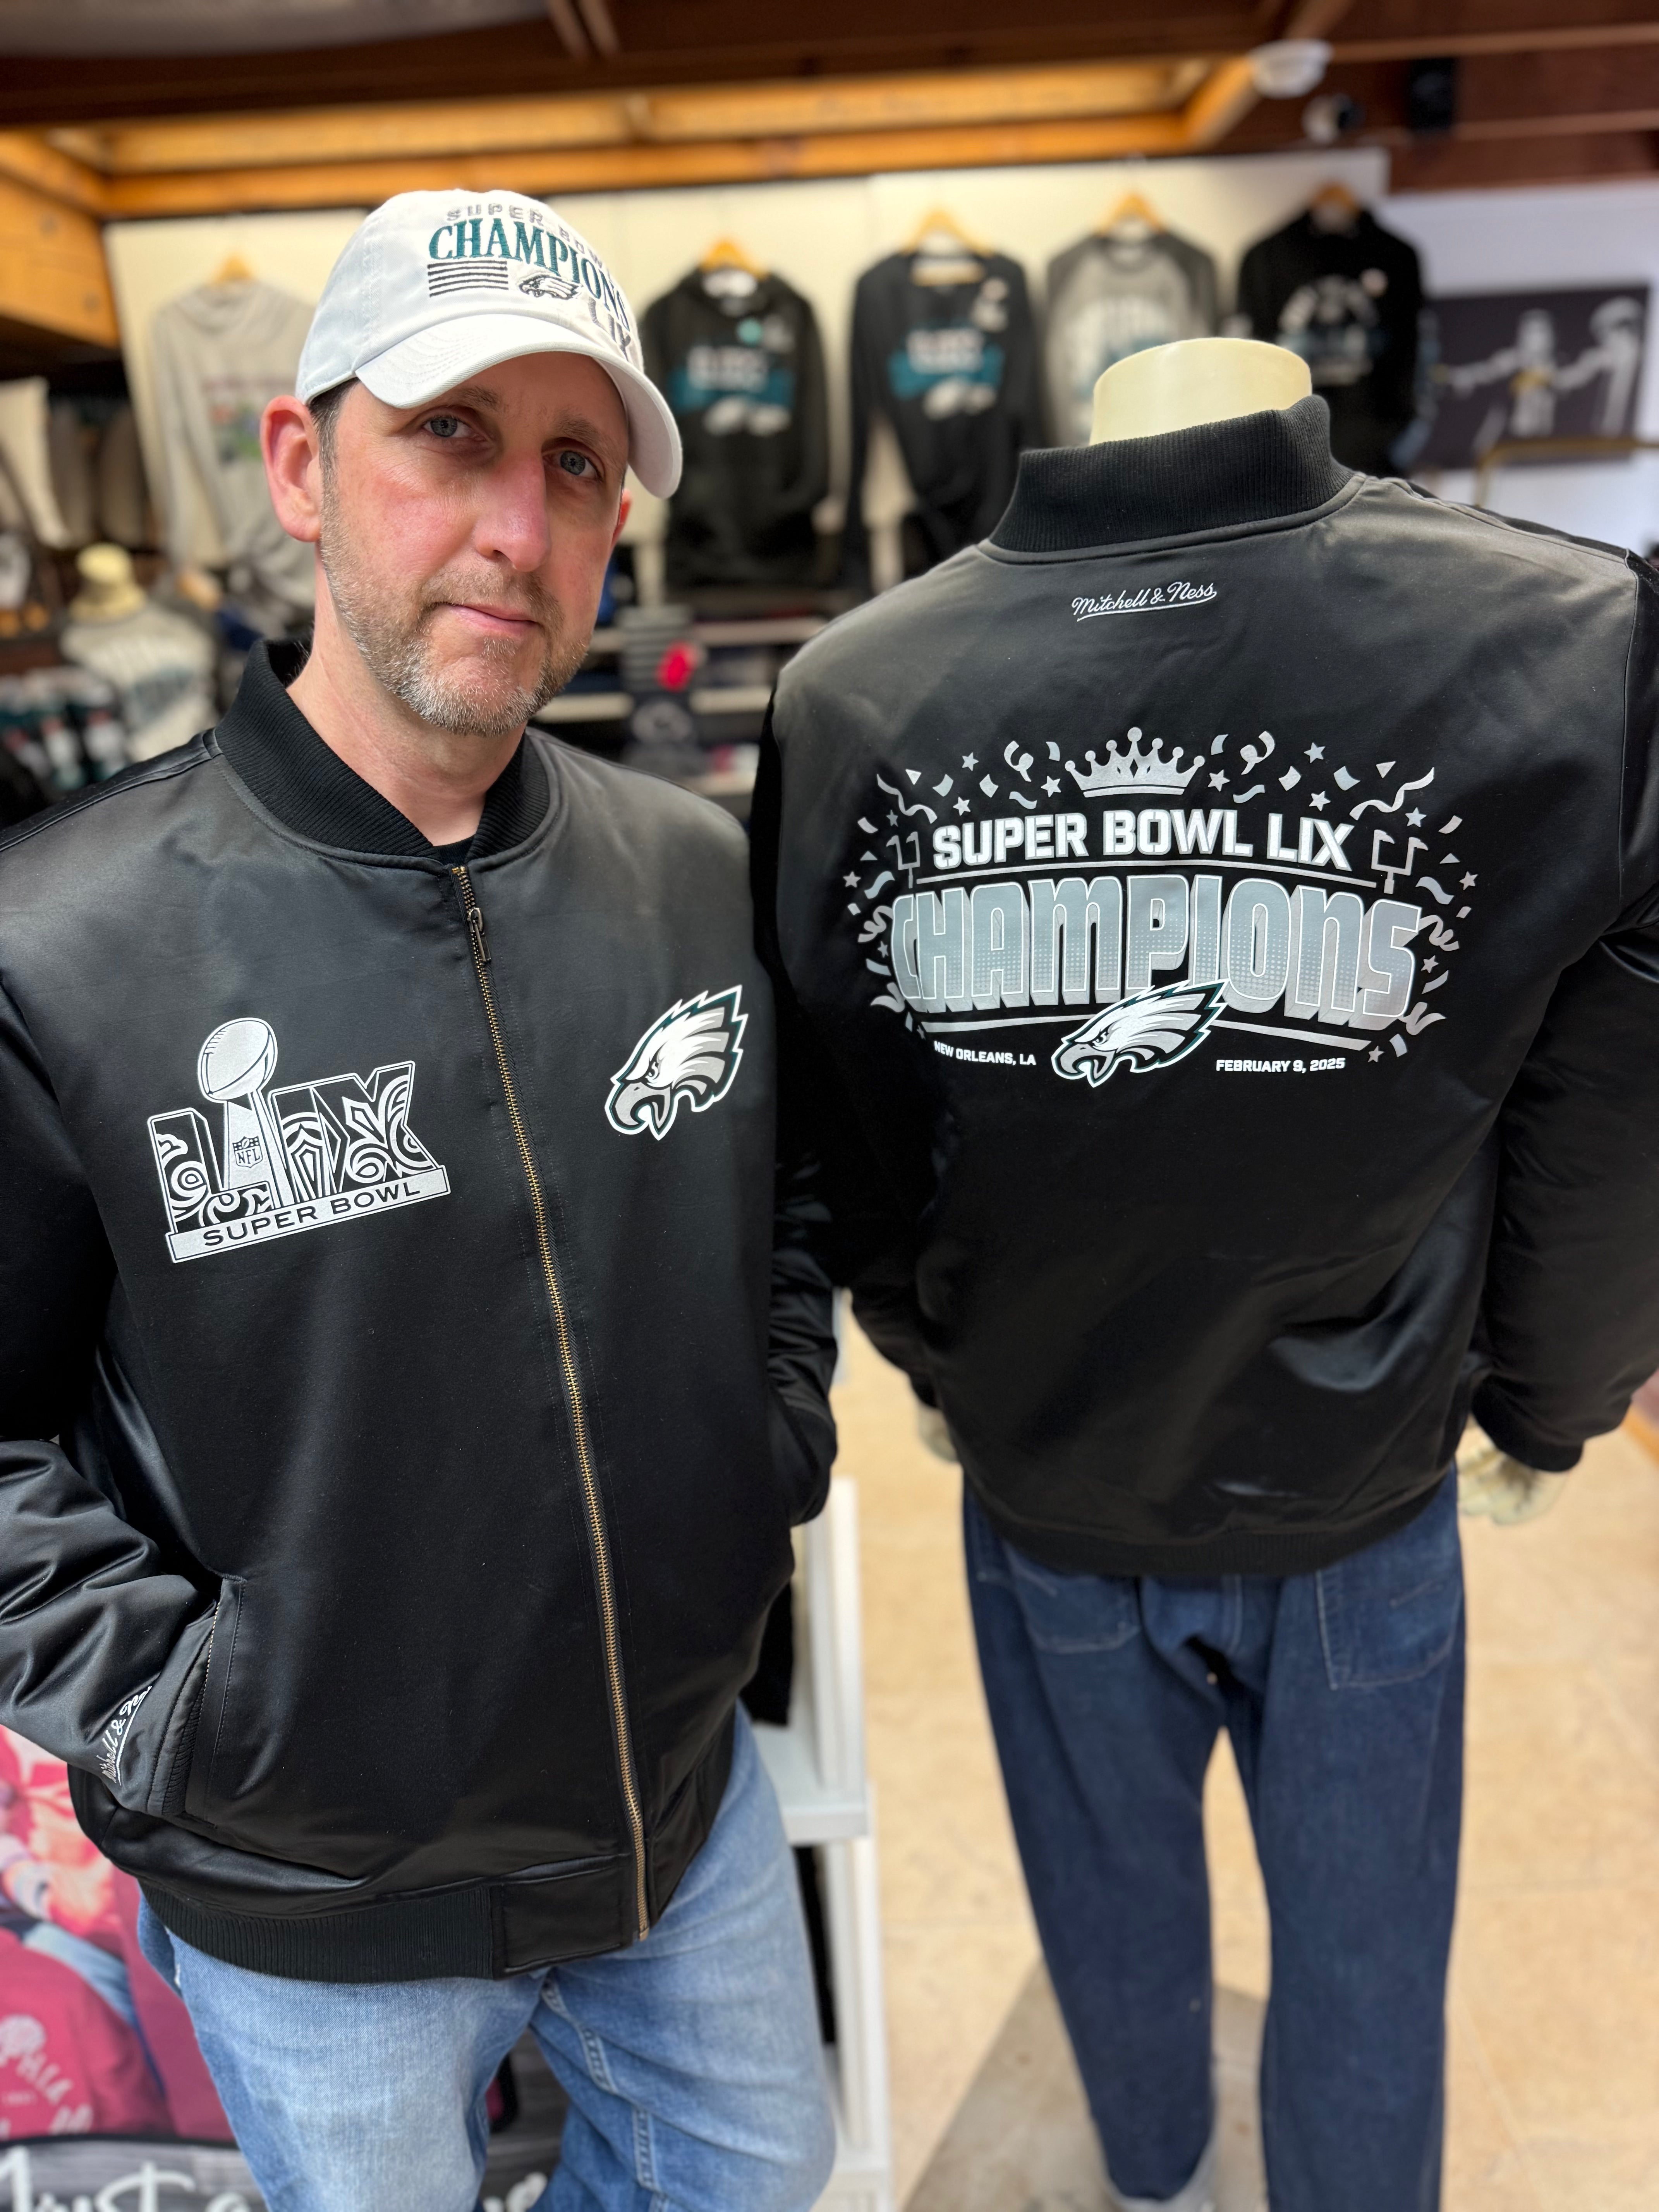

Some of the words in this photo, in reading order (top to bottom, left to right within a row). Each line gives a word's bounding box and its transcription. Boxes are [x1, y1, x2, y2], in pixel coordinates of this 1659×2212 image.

[446, 203, 544, 227] SUPER
[429, 218, 630, 332] CHAMPIONS
[1072, 588, 1151, 616] Mitchell
[1150, 587, 1165, 604] &
[1167, 582, 1217, 603] Ness
[933, 812, 1089, 870] SUPER
[1103, 809, 1253, 857] BOWL
[1266, 813, 1355, 871] LIX
[891, 874, 1422, 1029] CHAMPIONS
[934, 1041, 954, 1057] NEW
[956, 1048, 1016, 1066] ORLEANS,
[1020, 1053, 1037, 1065] LA
[1216, 1060, 1291, 1072] FEBRUARY
[1293, 1060, 1306, 1073] 9,
[1309, 1058, 1346, 1072] 2025
[237, 1148, 260, 1164] NFL
[203, 1206, 318, 1246] SUPER
[331, 1182, 421, 1215] BOWL
[111, 1719, 126, 1736] &
